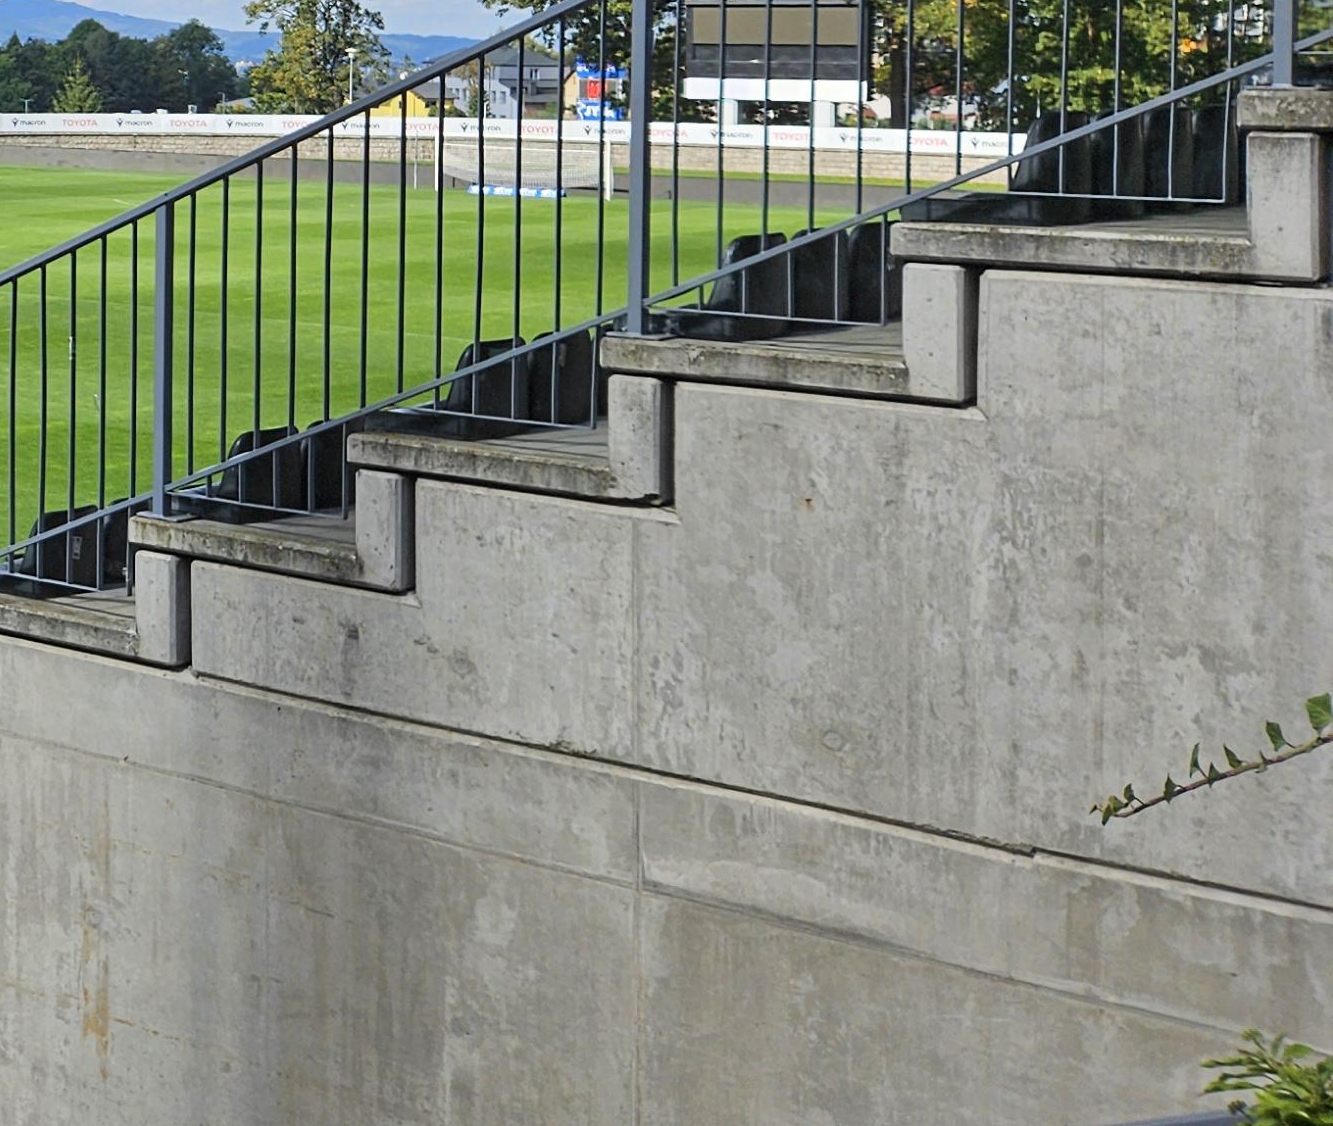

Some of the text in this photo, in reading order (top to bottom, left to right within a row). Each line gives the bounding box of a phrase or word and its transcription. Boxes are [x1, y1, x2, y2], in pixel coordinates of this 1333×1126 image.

[20, 118, 46, 127] macron
[62, 119, 98, 127] TOYOTA
[170, 120, 207, 128] TOYOTA
[235, 120, 264, 128] macron
[282, 121, 309, 129] TOYO
[406, 122, 439, 131] OYOTA
[522, 125, 555, 134] TOYOT
[649, 129, 688, 137] OYOA
[773, 132, 808, 141] TOYOT
[910, 137, 948, 146] OYOTA
